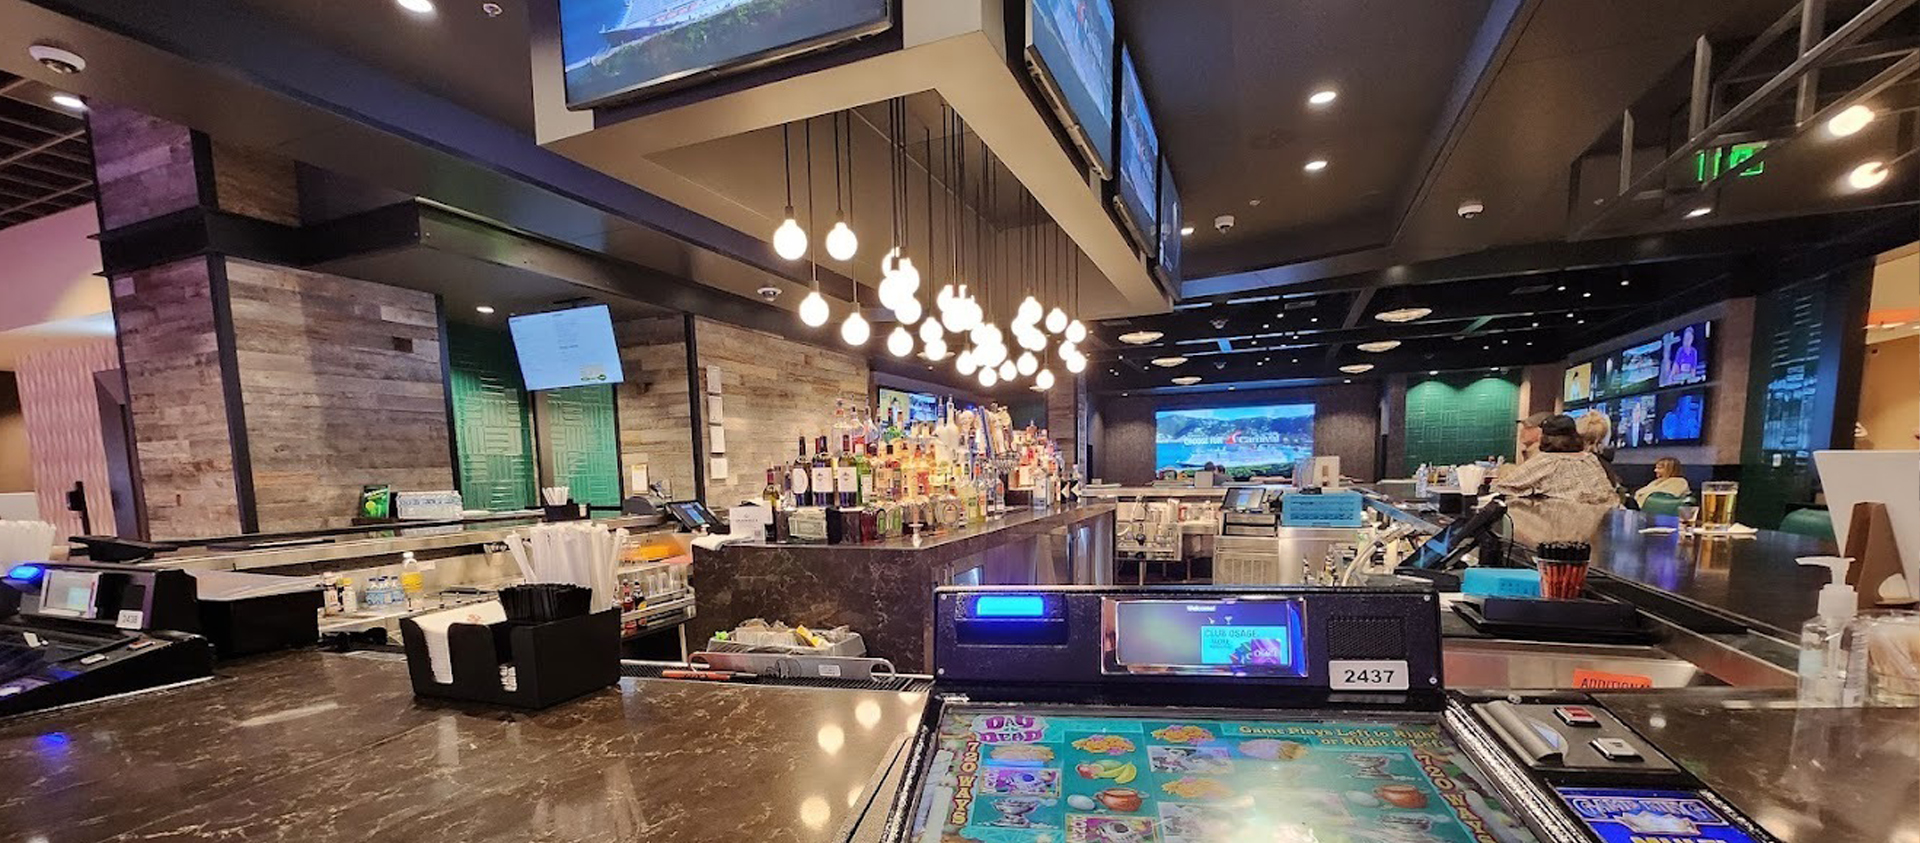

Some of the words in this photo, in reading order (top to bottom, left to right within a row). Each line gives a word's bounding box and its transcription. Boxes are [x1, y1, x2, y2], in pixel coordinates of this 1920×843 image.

[1344, 669, 1395, 684] 2437
[984, 714, 1035, 729] DAY
[980, 729, 1043, 742] DEAD
[1239, 726, 1284, 736] Game
[1287, 726, 1334, 738] Plays
[1338, 728, 1371, 739] Left
[1374, 730, 1389, 738] to
[1393, 729, 1437, 741] Right
[1321, 738, 1335, 746] or
[1340, 736, 1387, 748] Right
[1410, 738, 1445, 749] Left
[960, 741, 980, 773] 720
[1415, 753, 1455, 793] 720
[950, 776, 976, 825] WAYS
